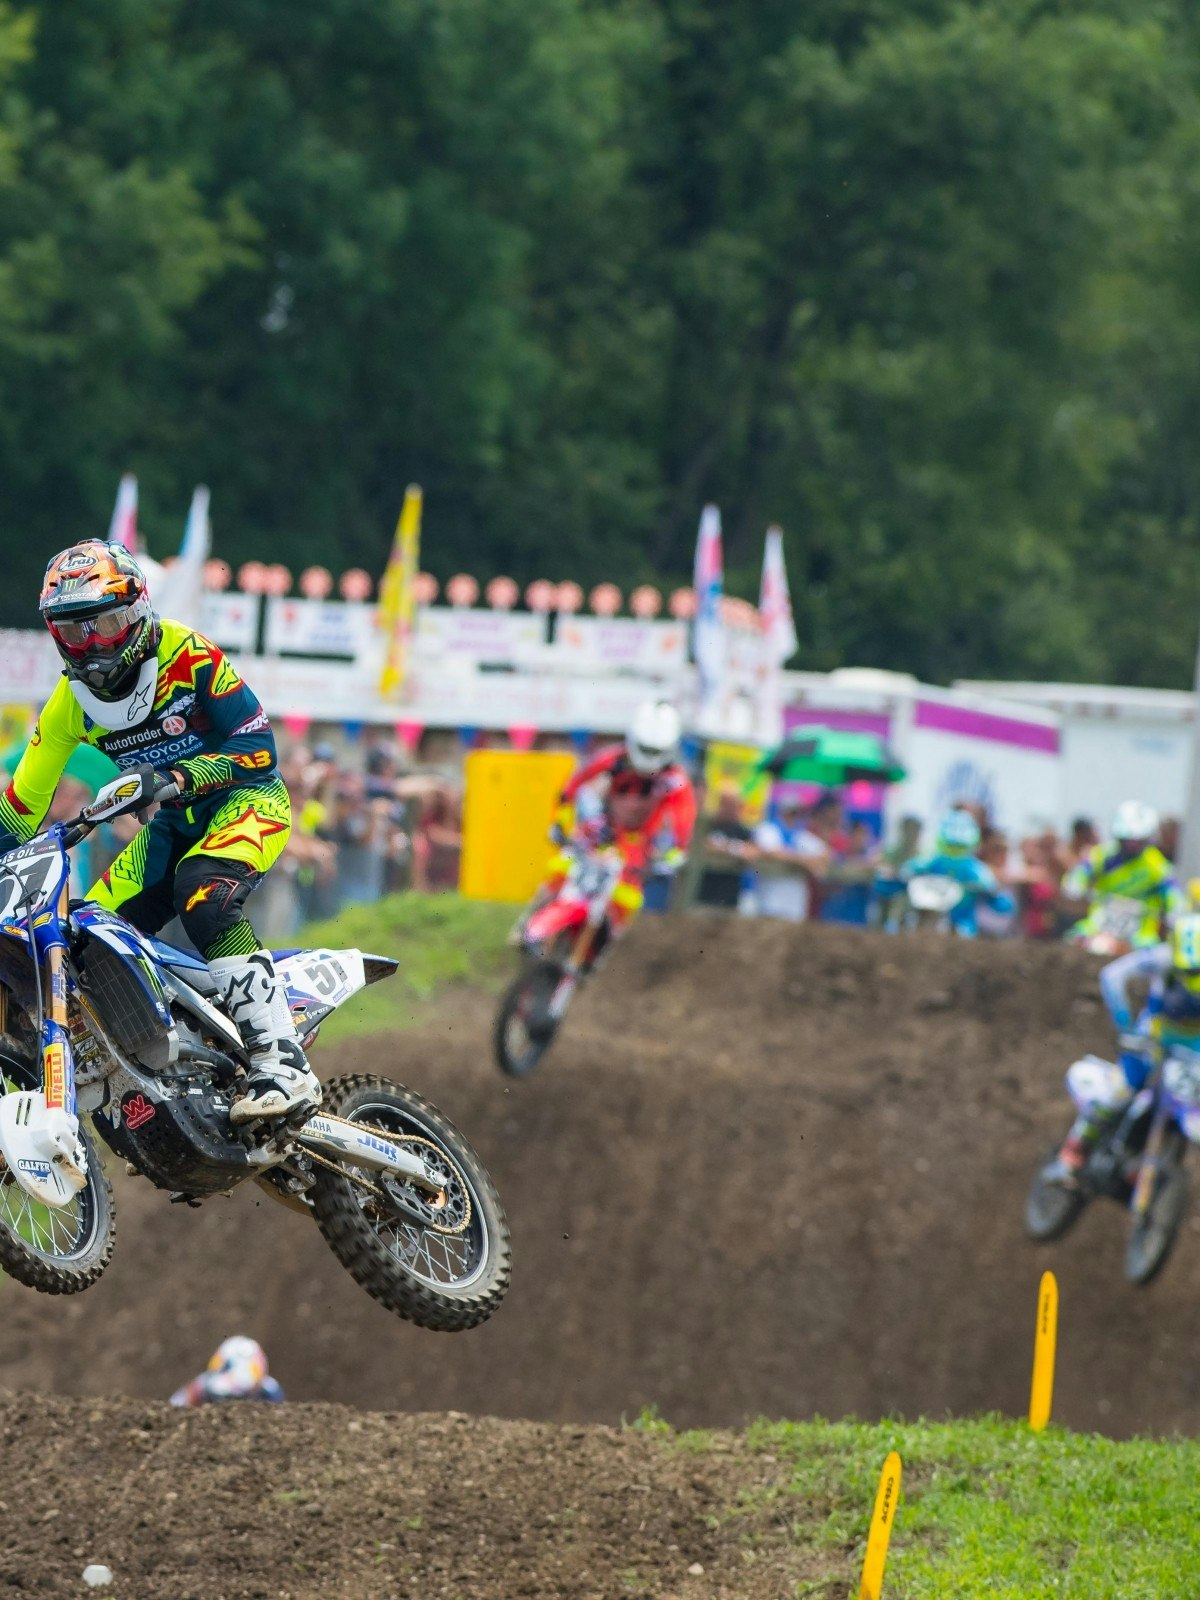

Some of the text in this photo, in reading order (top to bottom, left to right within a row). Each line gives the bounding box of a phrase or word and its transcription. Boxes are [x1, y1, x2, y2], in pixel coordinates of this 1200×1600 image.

[63, 556, 91, 569] Arai
[104, 728, 162, 752] Autotrader
[140, 733, 199, 762] TOYOTA
[166, 753, 178, 763] Go
[178, 741, 204, 757] Places
[16, 846, 36, 858] OIL
[311, 1005, 329, 1017] SCOTT
[46, 1052, 64, 1109] PIRELLI
[356, 1135, 398, 1161] JGR
[18, 1160, 51, 1172] GALFER
